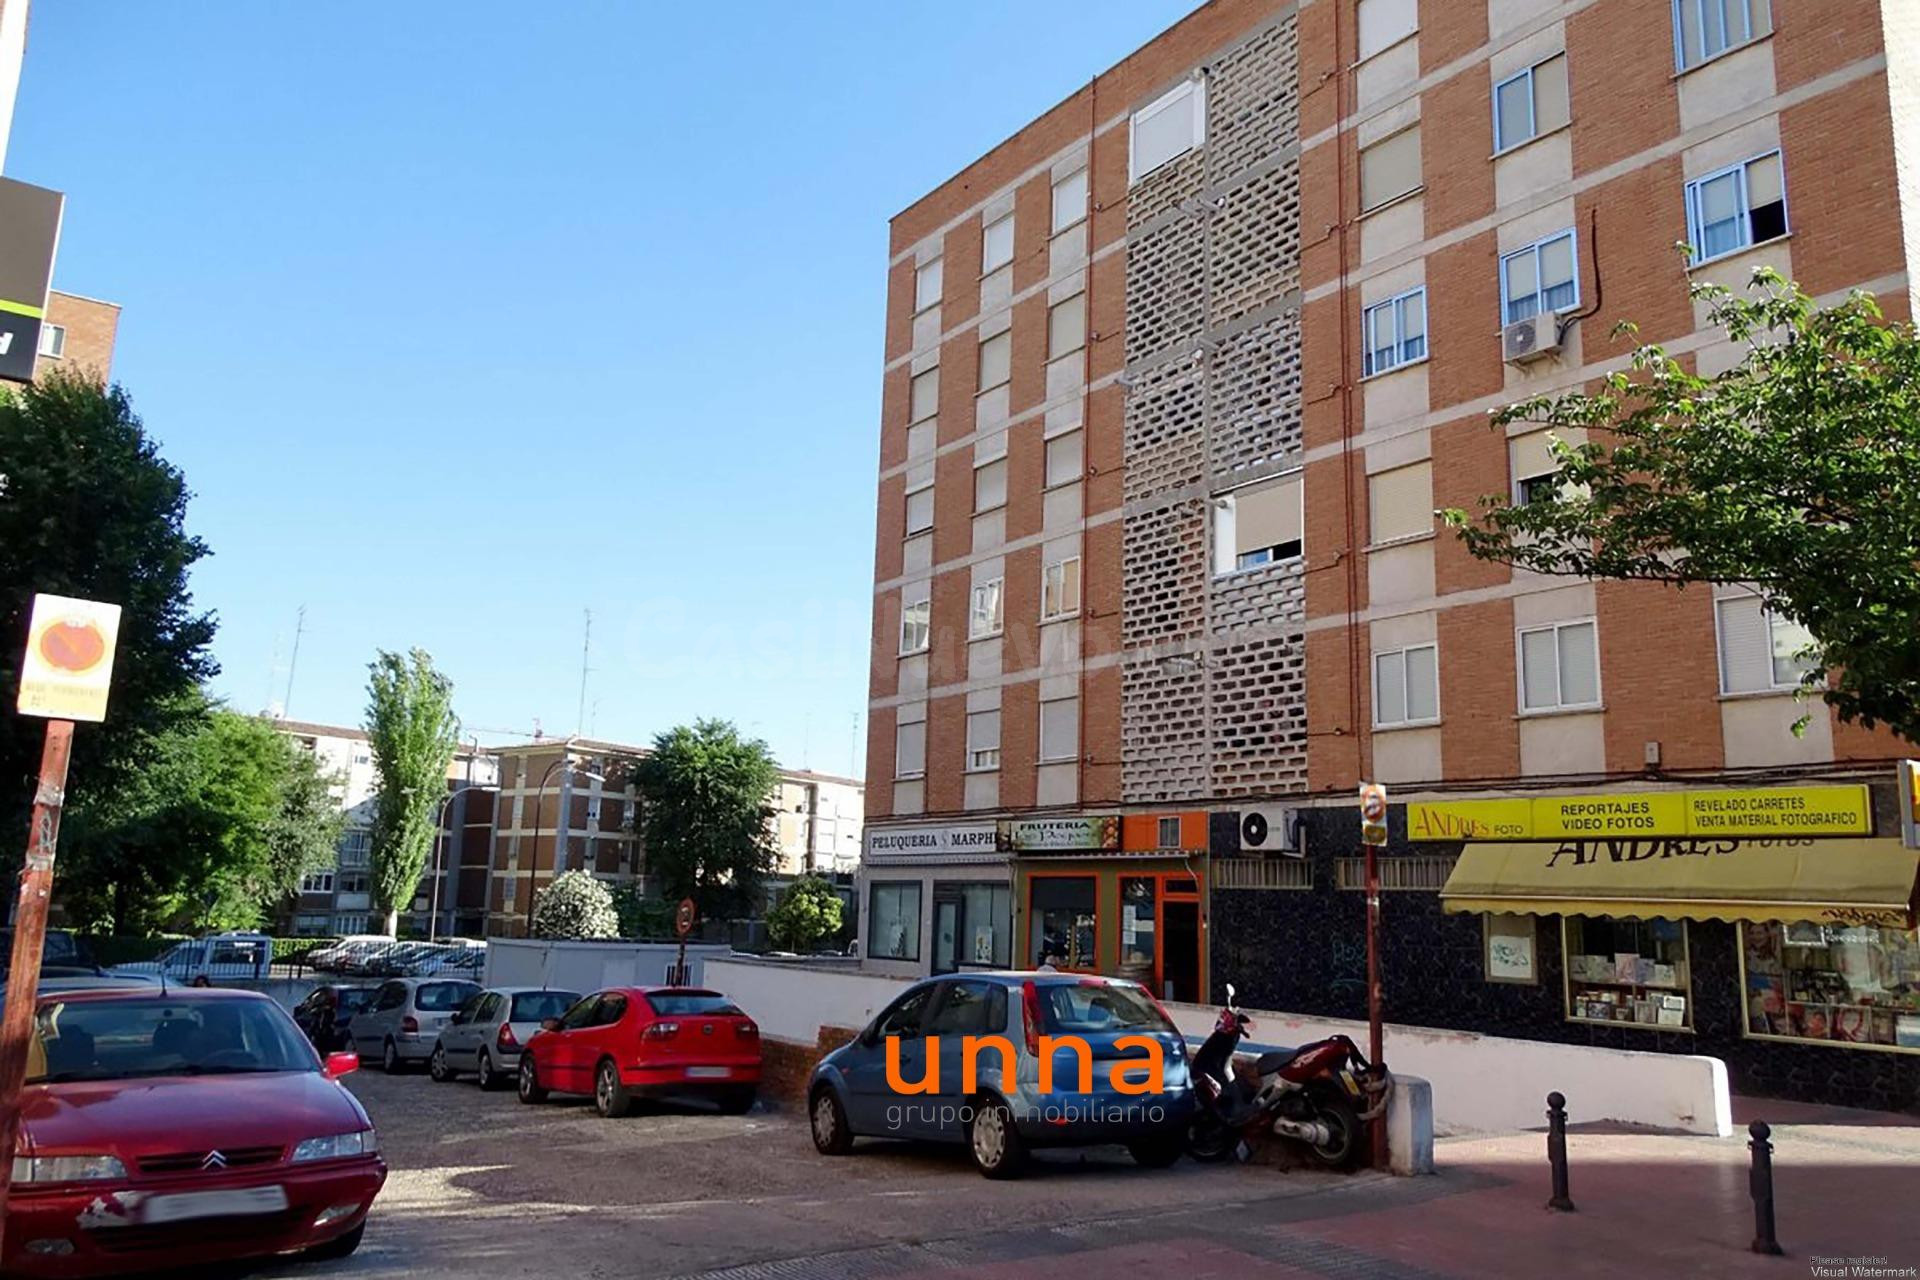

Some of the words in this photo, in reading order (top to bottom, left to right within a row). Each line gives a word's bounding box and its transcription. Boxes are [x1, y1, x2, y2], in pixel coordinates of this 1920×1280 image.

[1561, 802, 1650, 816] REPORTAJES
[1694, 799, 1747, 812] REVELADO
[1751, 797, 1805, 811] CARRETES
[1562, 818, 1602, 830] VIDEO
[1607, 816, 1655, 829] FOTOS
[1695, 815, 1726, 827] VENTA
[1729, 813, 1778, 827] MATERIAL
[1781, 811, 1857, 826] FOTOGRAFICO
[1494, 824, 1524, 835] FOTO
[872, 834, 938, 850] PELUQUERIA
